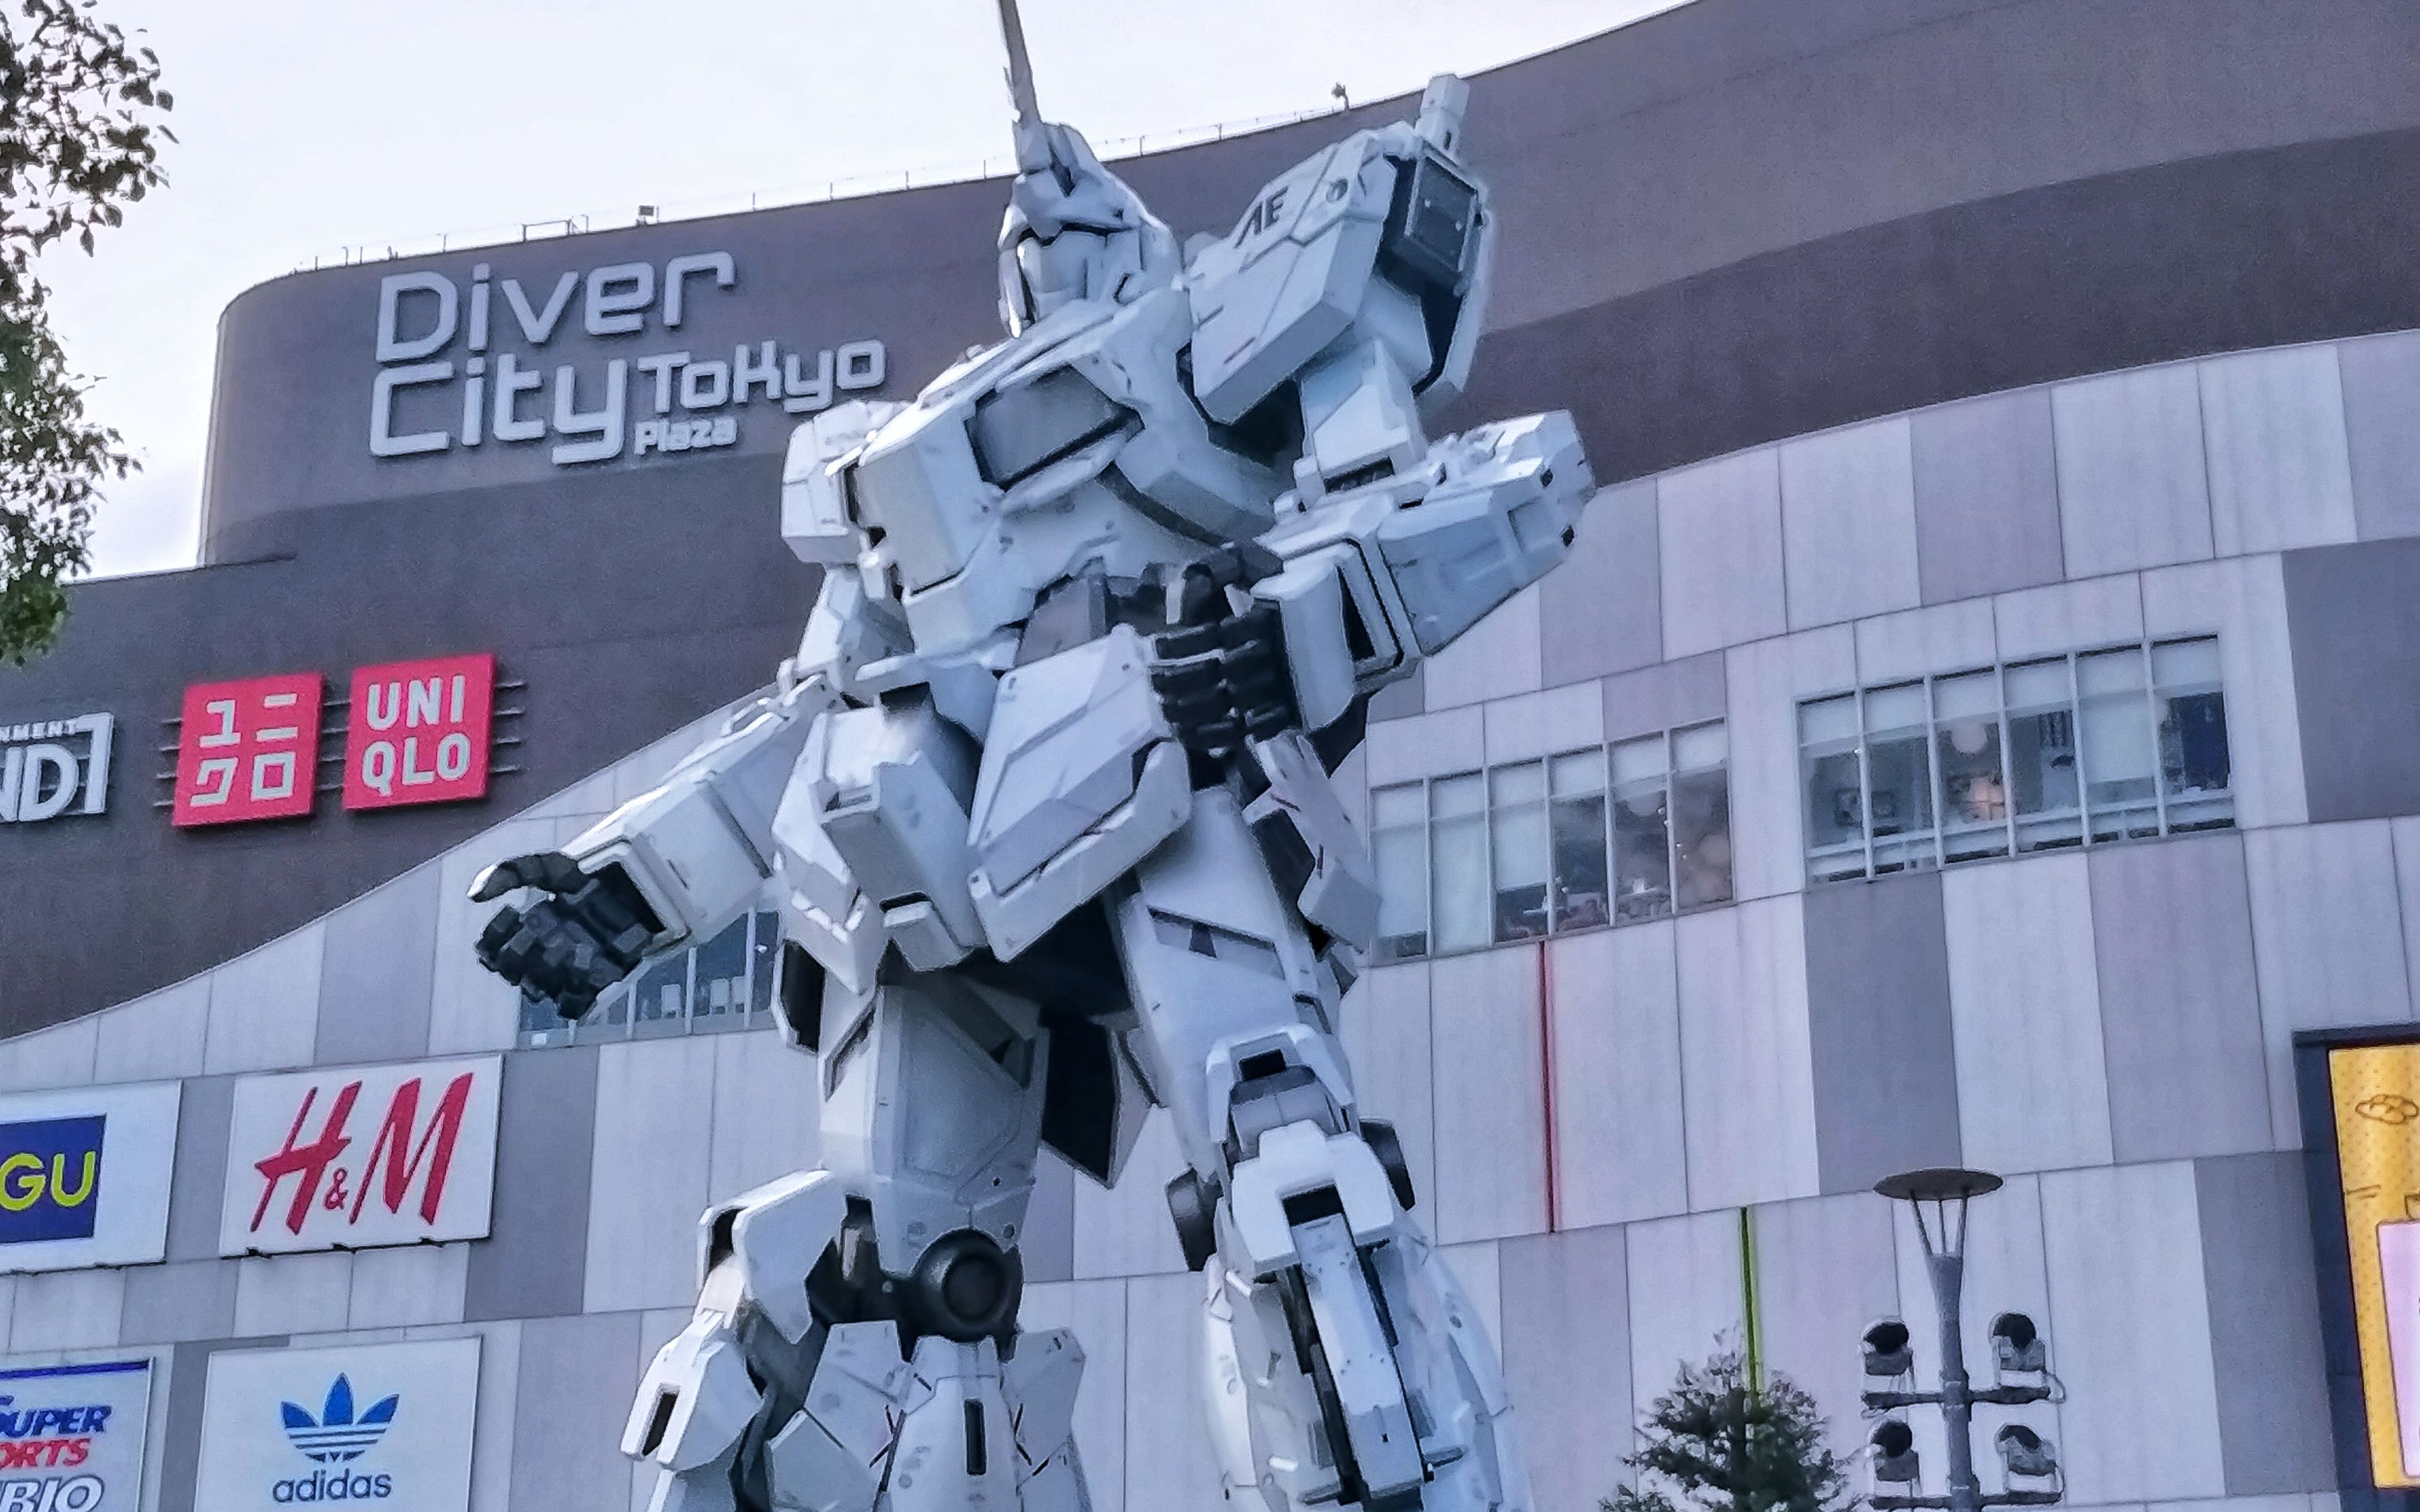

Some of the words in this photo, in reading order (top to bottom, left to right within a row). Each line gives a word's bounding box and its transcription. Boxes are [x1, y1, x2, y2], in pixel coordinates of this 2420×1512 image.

[375, 251, 735, 364] Diver
[369, 353, 628, 465] City
[366, 674, 466, 732] UNI
[361, 732, 471, 797] QLO
[0, 1151, 96, 1212] GU
[0, 1474, 104, 1512] BIO
[272, 1467, 392, 1503] adidas
